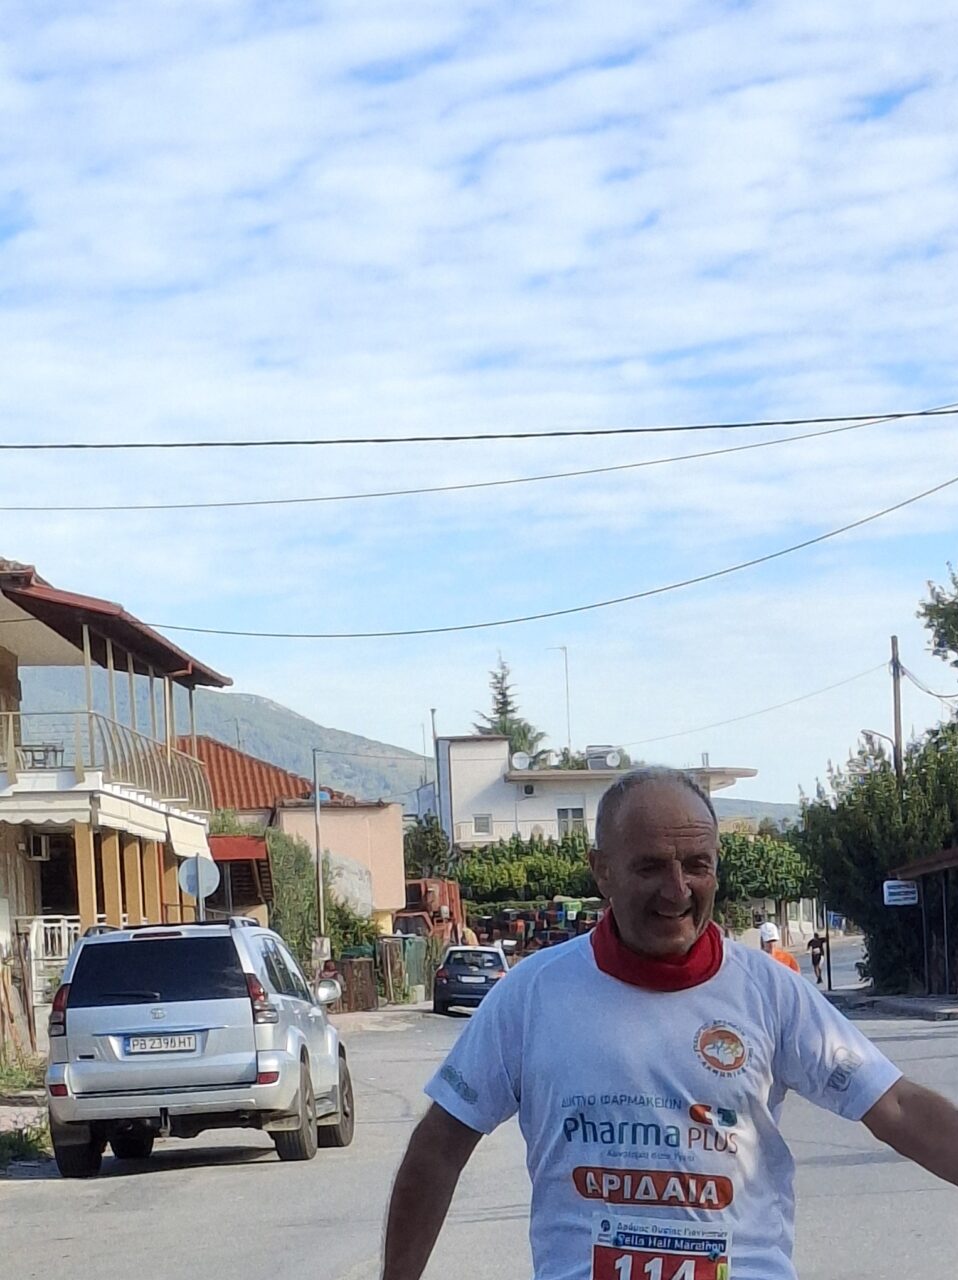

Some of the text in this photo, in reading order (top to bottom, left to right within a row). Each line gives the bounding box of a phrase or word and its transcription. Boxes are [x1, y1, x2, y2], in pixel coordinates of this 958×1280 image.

[600, 1094, 682, 1110] ΦΑΡΜΑΚΕΙΩΝ
[563, 1113, 738, 1154] Pharma PLUS
[586, 1171, 719, 1205] ΑΡΙΔΑΙΑ
[648, 1236, 671, 1249] Half
[674, 1239, 725, 1251] Marathon
